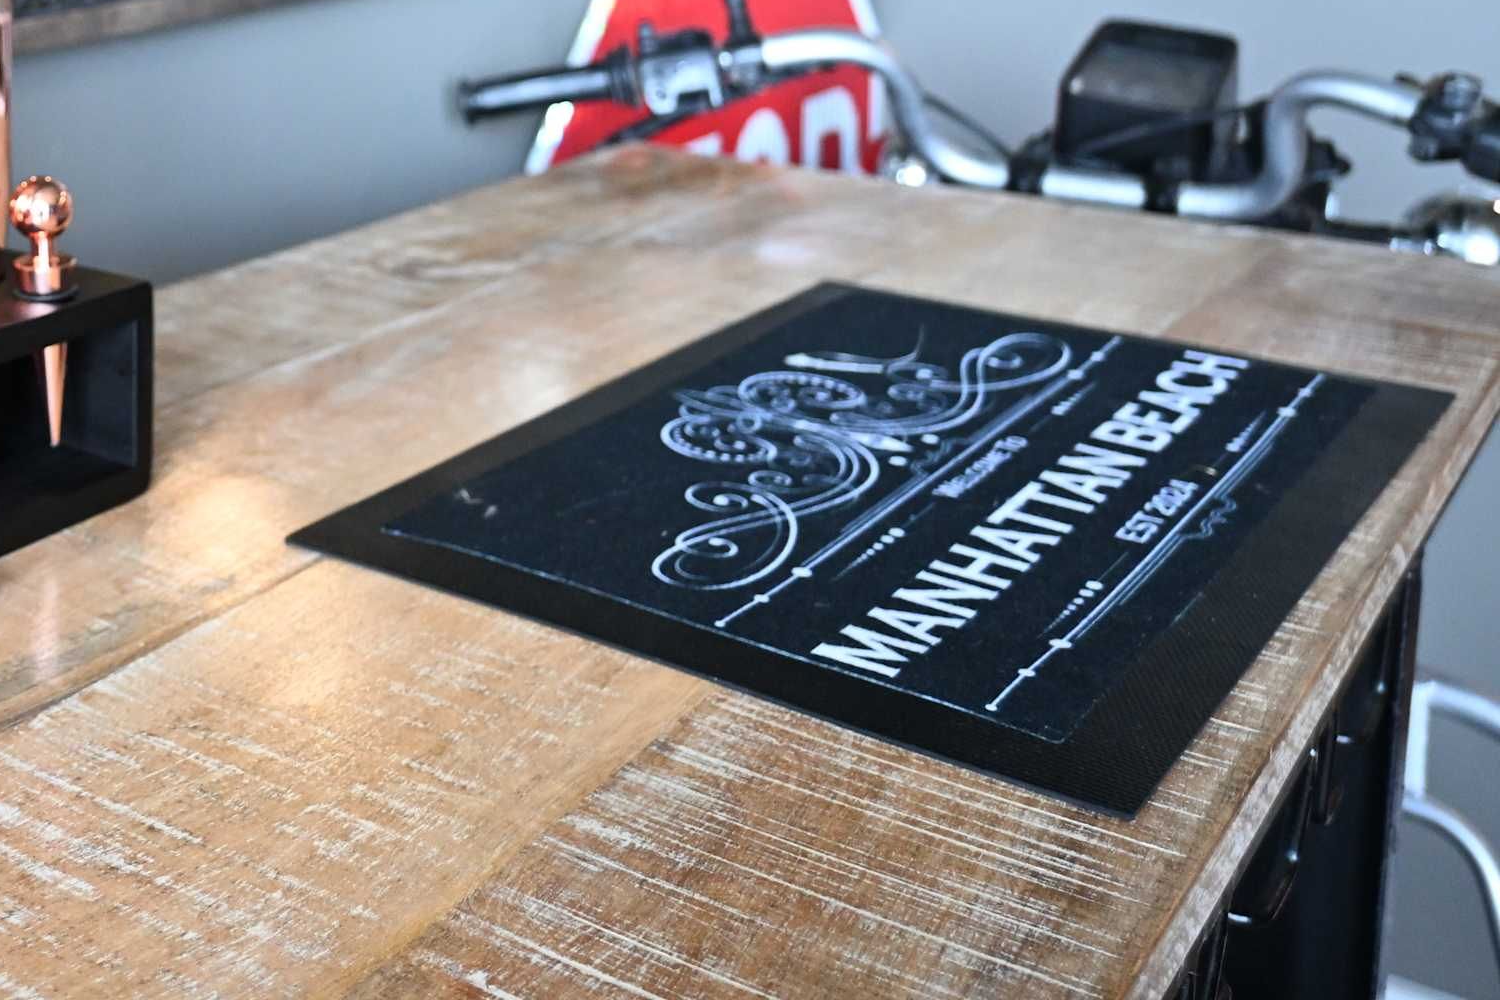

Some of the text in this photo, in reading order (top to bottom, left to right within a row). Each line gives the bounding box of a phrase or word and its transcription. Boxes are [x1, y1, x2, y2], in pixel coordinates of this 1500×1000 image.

[810, 349, 1249, 678] MANHATTAN BEACH
[1114, 510, 1165, 544] EST
